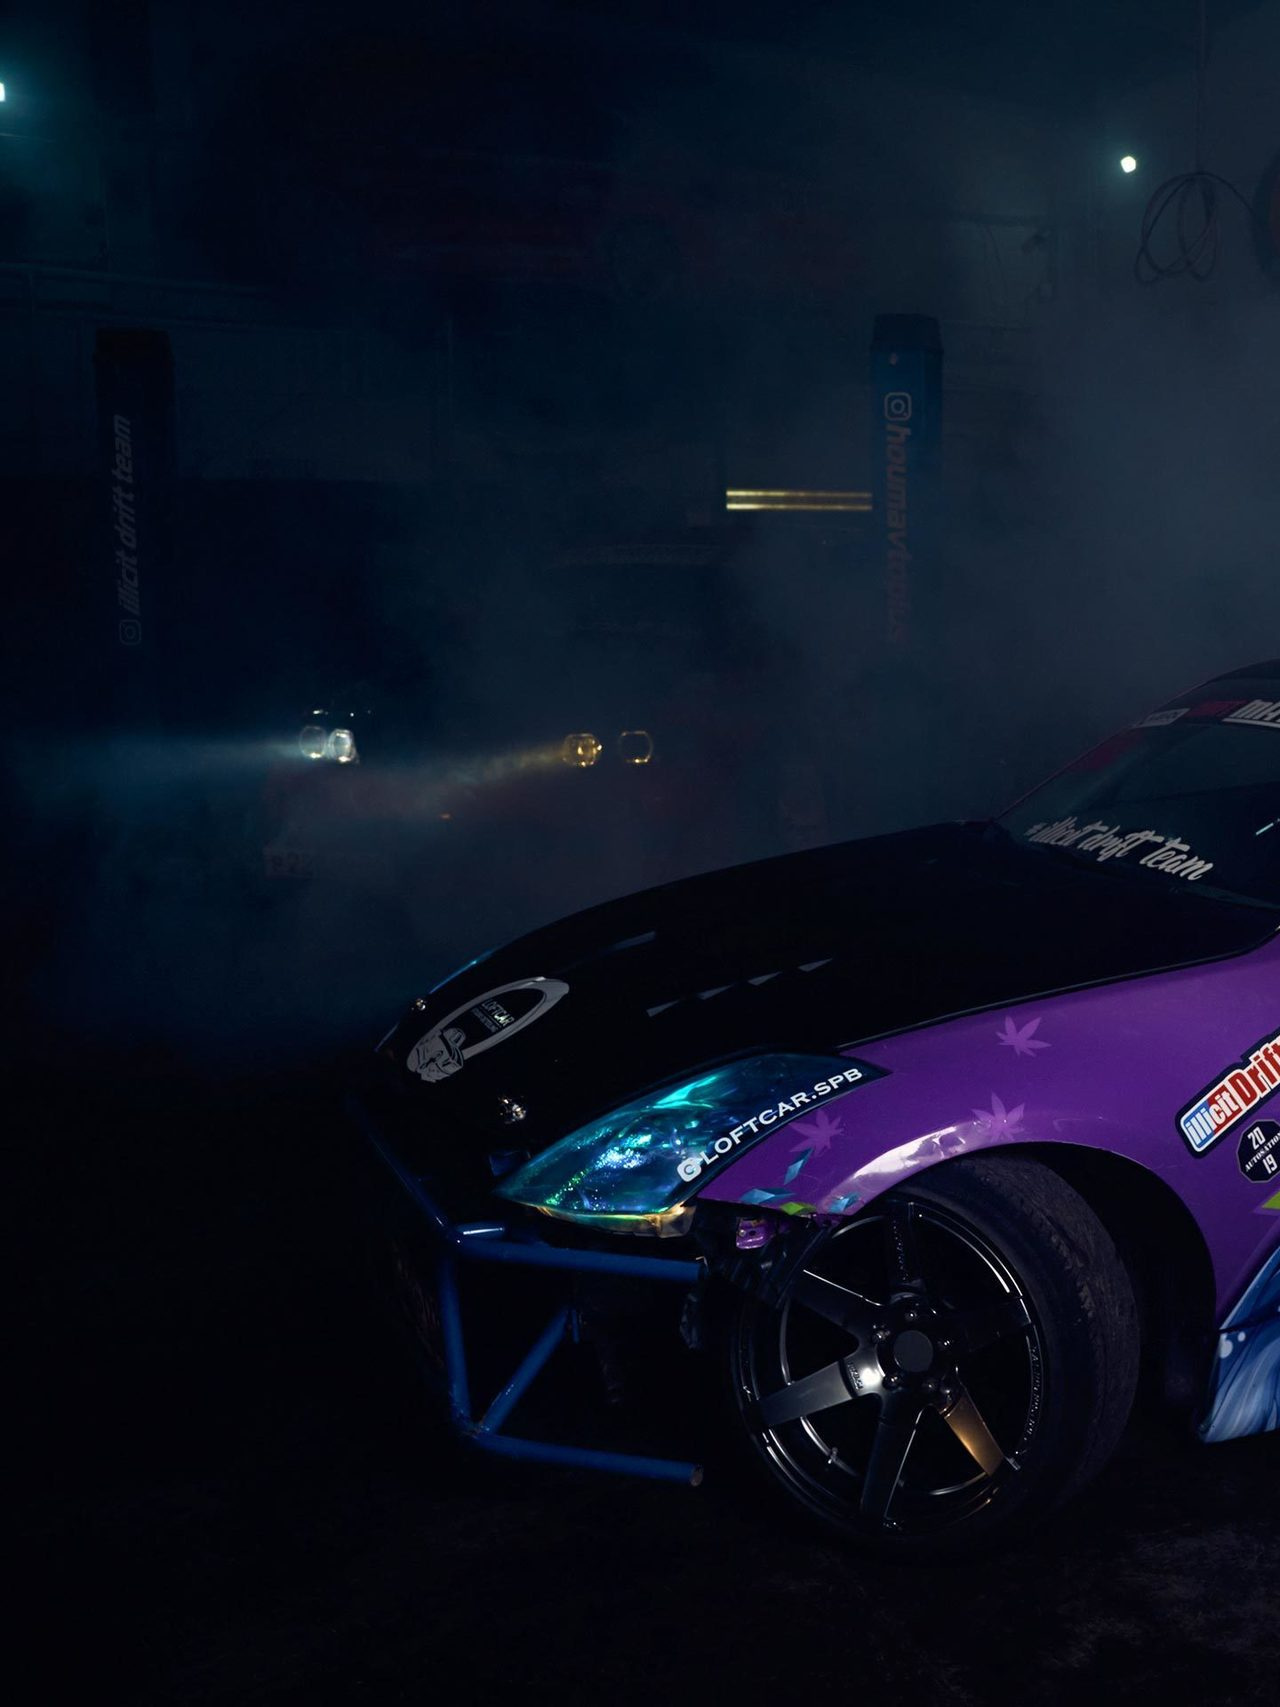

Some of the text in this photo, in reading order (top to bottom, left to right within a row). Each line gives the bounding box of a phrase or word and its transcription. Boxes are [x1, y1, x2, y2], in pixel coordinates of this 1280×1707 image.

[699, 1068, 864, 1166] LOFTCAR.SPB
[1247, 1126, 1267, 1151] 20
[1262, 1153, 1279, 1175] 19
